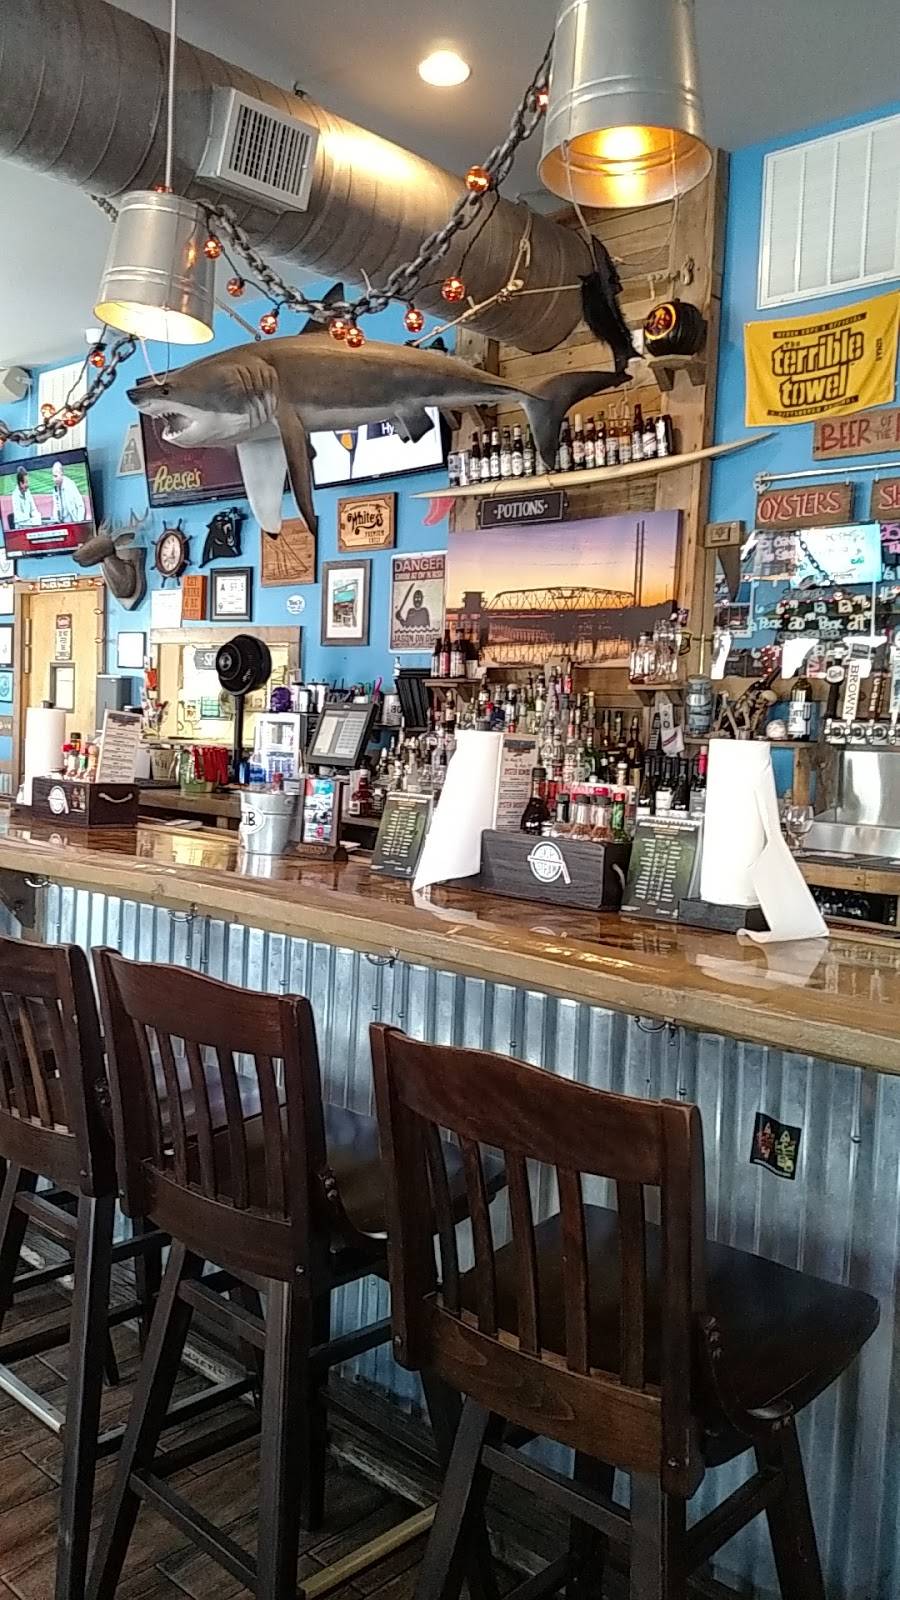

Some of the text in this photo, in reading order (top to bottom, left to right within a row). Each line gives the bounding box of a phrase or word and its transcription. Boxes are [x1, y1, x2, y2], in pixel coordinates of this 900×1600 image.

[772, 328, 864, 376] terrible
[780, 362, 849, 408] towel
[821, 418, 871, 451] BEER
[153, 465, 201, 493] Reese's
[496, 499, 545, 520] POTIONS
[758, 490, 841, 522] OYSTERS
[394, 558, 444, 572] DANGER
[845, 664, 859, 715] BROWN
